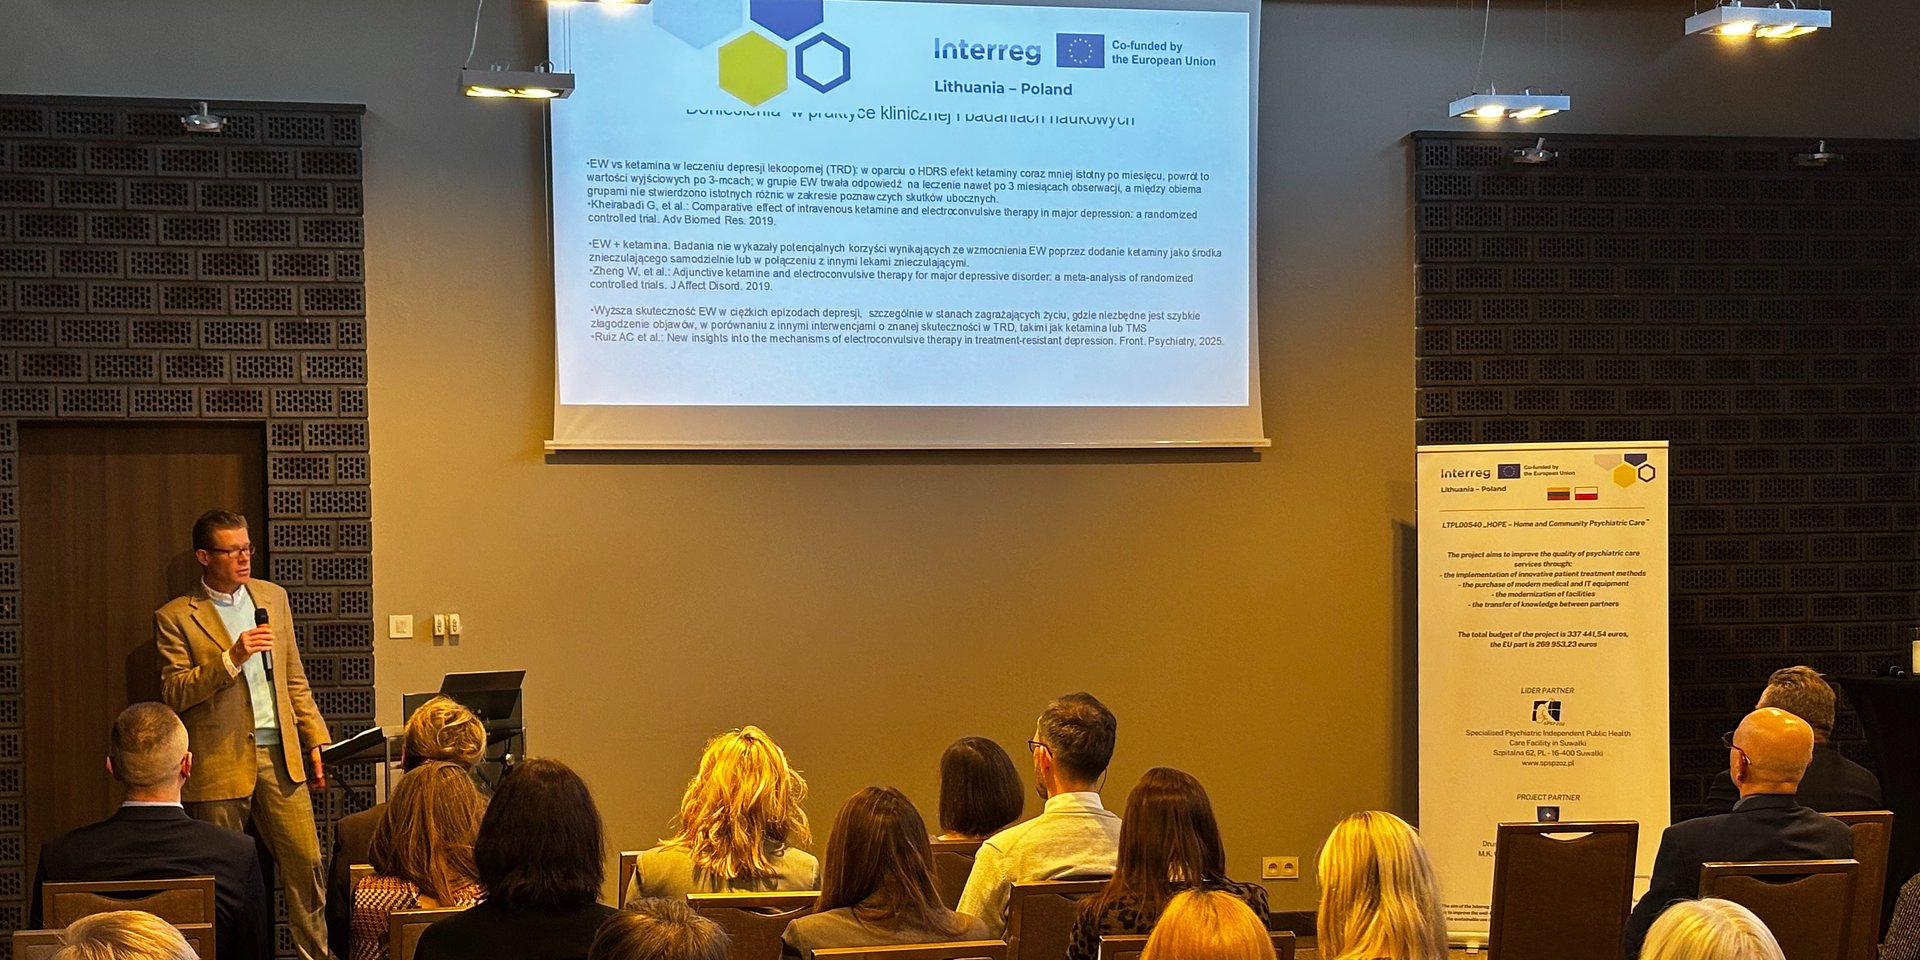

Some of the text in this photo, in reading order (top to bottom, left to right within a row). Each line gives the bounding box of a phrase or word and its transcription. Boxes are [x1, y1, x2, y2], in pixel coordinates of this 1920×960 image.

[934, 37, 1041, 66] Interreg
[1112, 40, 1182, 53] Co-funded by
[1112, 54, 1216, 67] the European Union
[935, 80, 1005, 94] Lithuania
[1021, 82, 1072, 96] Poland
[591, 200, 644, 210] Kheirabadi
[661, 202, 671, 210] et
[691, 202, 753, 214] Comparative
[756, 203, 783, 212] effect
[785, 203, 795, 212] of
[797, 203, 852, 213] intravenous
[854, 204, 898, 214] ketamine
[901, 205, 918, 215] and
[921, 206, 1001, 216] electroconvulsive
[1003, 207, 1038, 219] therapy
[1040, 207, 1049, 216] in
[1051, 208, 1078, 219] major
[1144, 209, 1197, 218] randomized
[588, 213, 636, 223] controlled
[662, 214, 682, 223] Adv
[684, 214, 720, 224] Biomed
[669, 254, 734, 263] samodzielnie
[736, 254, 751, 264] lub
[826, 256, 857, 267] innymi
[859, 256, 891, 265] lekami
[593, 266, 624, 277] Zheng
[643, 267, 653, 276] et
[672, 267, 723, 279] Adjunctive
[725, 268, 770, 277] ketamine
[772, 268, 790, 278] and
[793, 269, 875, 279] electroconvulsive
[877, 270, 913, 281] therapy
[915, 271, 928, 280] for
[930, 271, 957, 282] major
[958, 271, 1009, 283] depressive
[1063, 272, 1126, 284] meta-analysis
[1128, 273, 1138, 282] of
[1140, 273, 1193, 282] randomized
[590, 279, 638, 288] controlled
[595, 332, 617, 341] Ruiz
[618, 332, 634, 341] AC
[637, 333, 647, 341] et
[666, 333, 688, 342] New
[691, 333, 728, 344] insights
[731, 333, 749, 342] into
[751, 333, 767, 342] the
[769, 333, 830, 342] mechanisms
[832, 334, 841, 343] of
[843, 334, 925, 343] electroconvulsive
[927, 334, 962, 346] therapy
[964, 335, 972, 343] in
[975, 335, 1062, 344] treatment-resistant
[1441, 468, 1490, 479] Interreg
[1548, 520, 1588, 528] Community
[1588, 519, 1627, 528] Psychiatric
[1460, 551, 1484, 559] project
[1511, 551, 1539, 559] improve
[1552, 550, 1576, 559] quality
[1585, 550, 1623, 558] psychiatric
[1488, 631, 1513, 639] budget
[1534, 631, 1559, 639] project
[1513, 641, 1527, 649] part
[1465, 729, 1504, 738] Specialised
[1504, 729, 1542, 738] Psychiatric
[1542, 730, 1584, 738] Independent
[1526, 739, 1551, 748] Facility
[1493, 749, 1524, 758] Szpitalna
